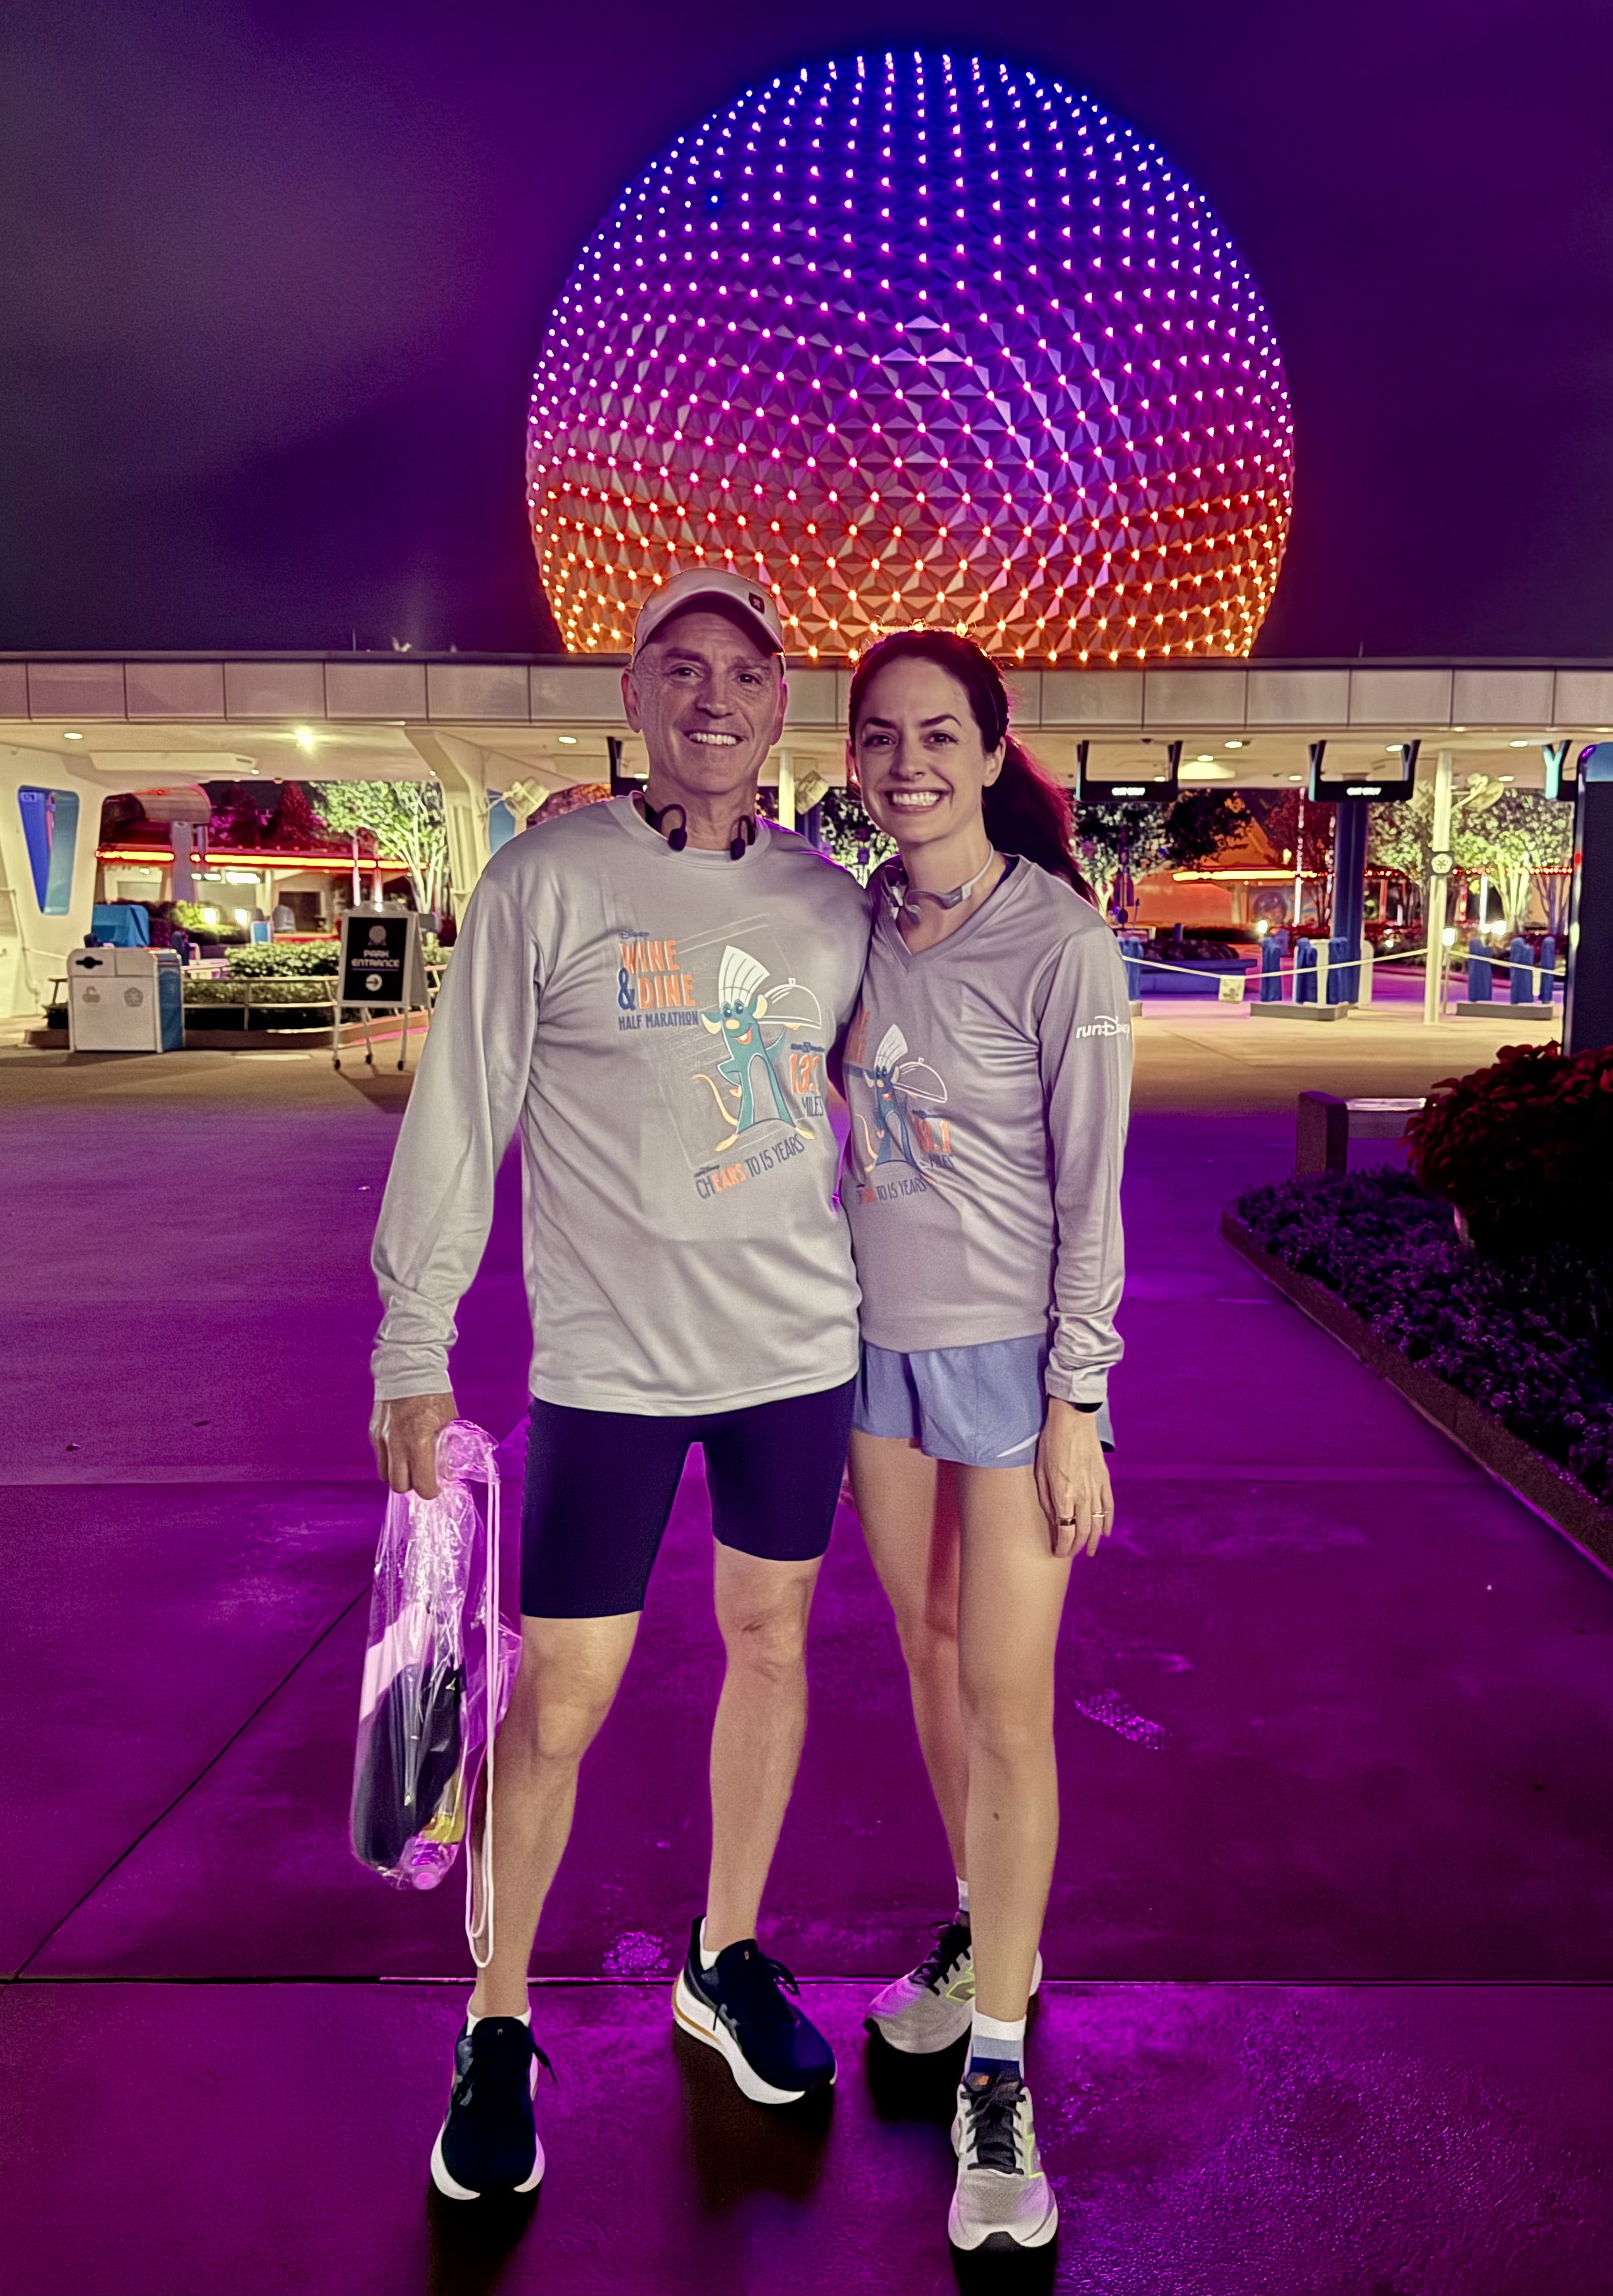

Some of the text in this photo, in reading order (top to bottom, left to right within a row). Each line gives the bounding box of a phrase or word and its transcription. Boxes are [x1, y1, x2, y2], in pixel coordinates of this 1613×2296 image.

[351, 958, 400, 968] ENTRANCE
[364, 949, 389, 959] PARK
[619, 939, 680, 974] WINE
[618, 968, 696, 1011] & DINE
[618, 1011, 699, 1031] HALF MARATHON
[695, 1163, 747, 1199] CHEARS
[744, 1156, 760, 1178] TO
[758, 1149, 774, 1170] 15
[771, 1134, 805, 1163] YEARS
[876, 1185, 887, 1201] TO
[897, 1177, 927, 1197] YEARS
